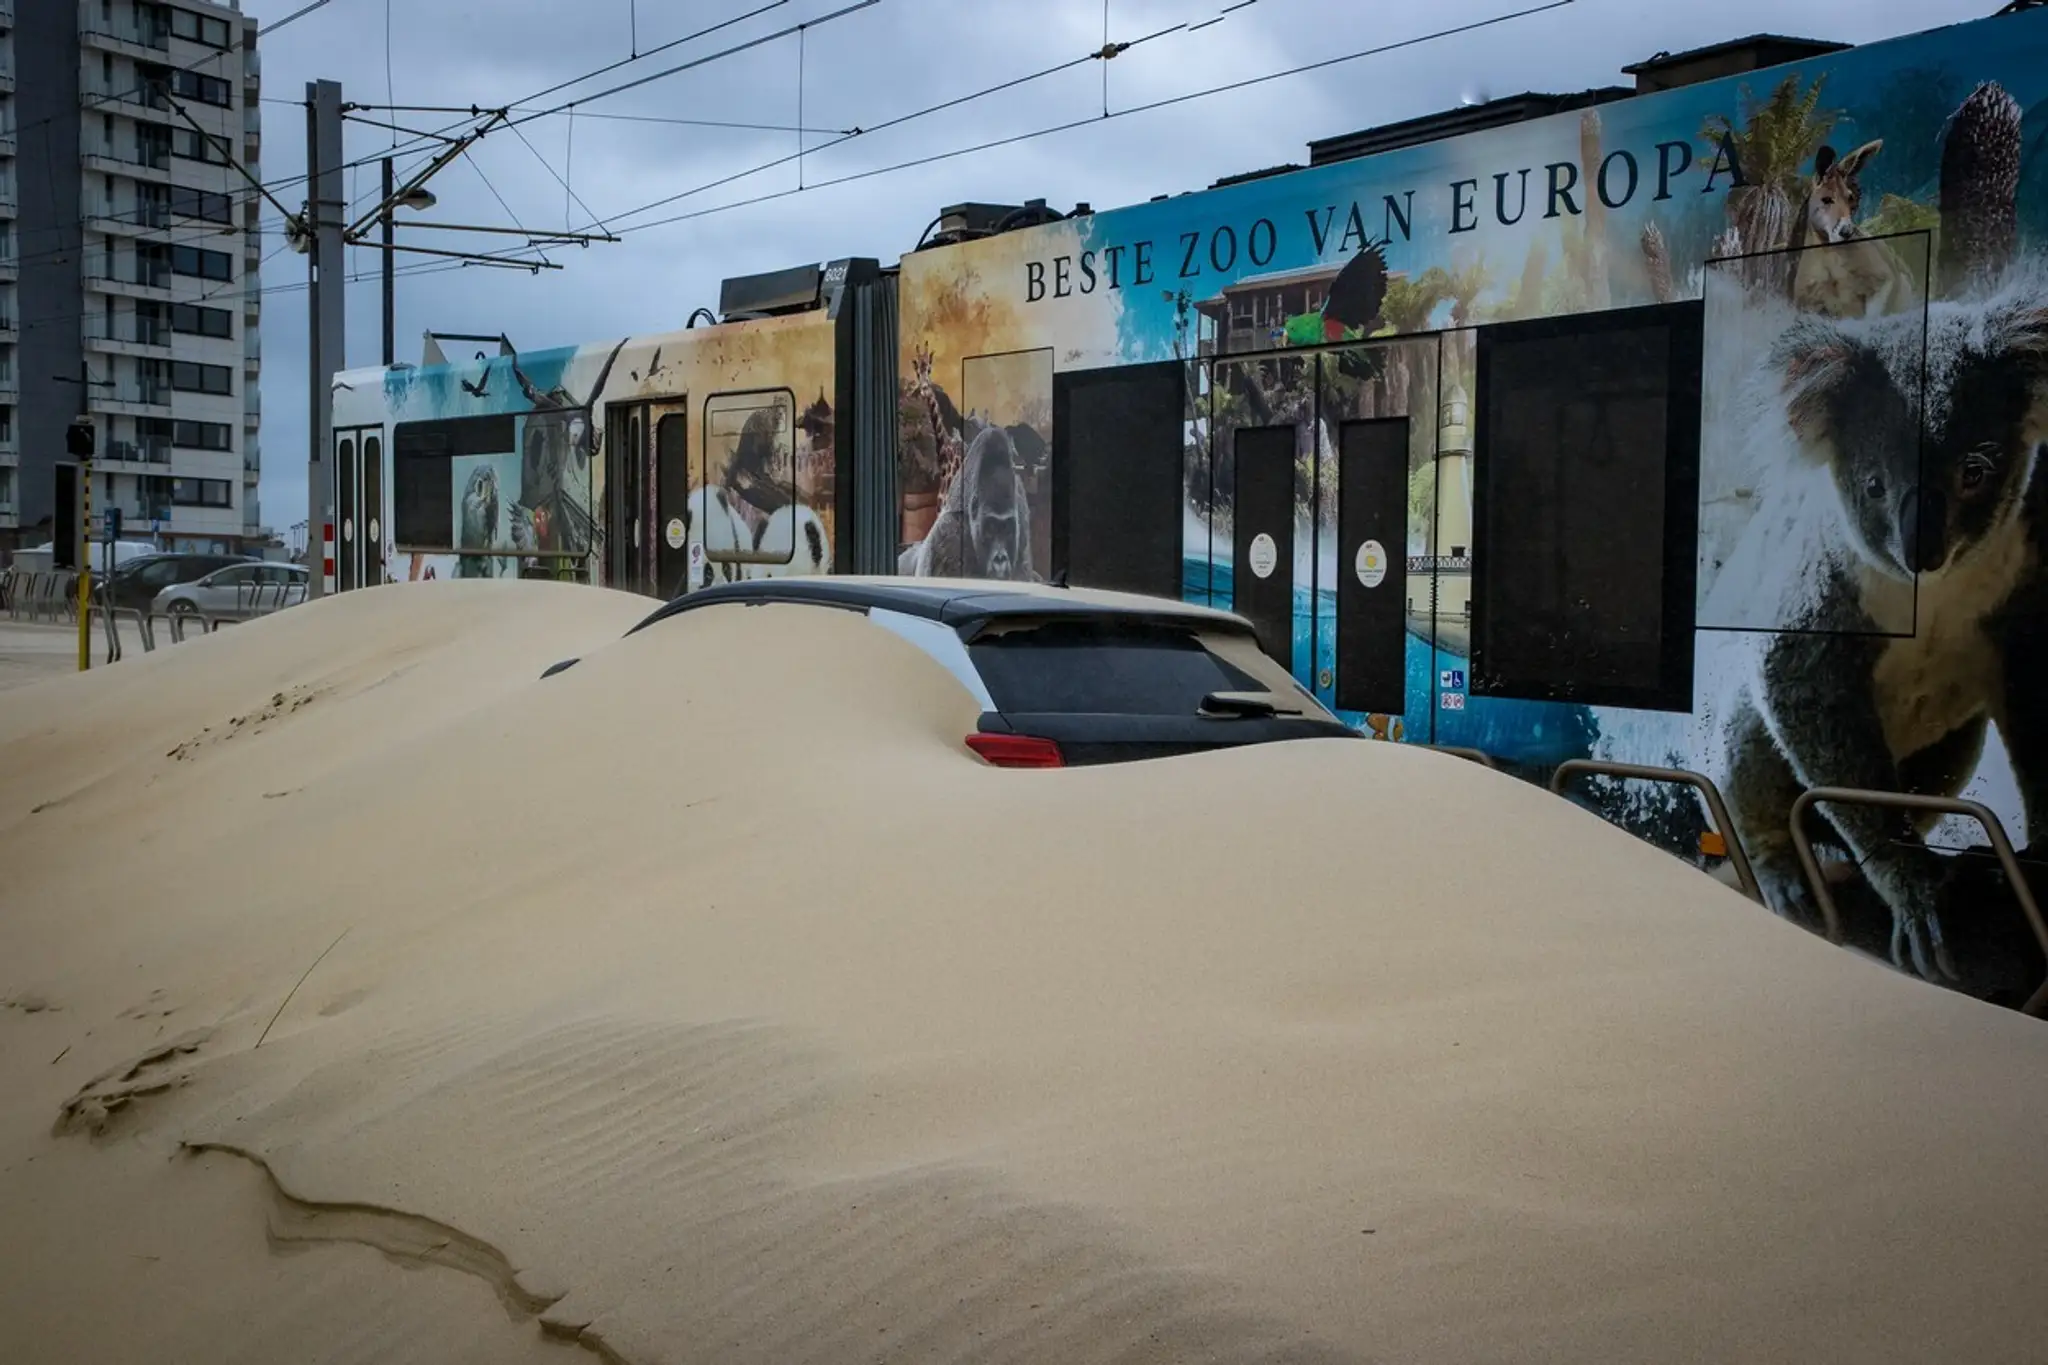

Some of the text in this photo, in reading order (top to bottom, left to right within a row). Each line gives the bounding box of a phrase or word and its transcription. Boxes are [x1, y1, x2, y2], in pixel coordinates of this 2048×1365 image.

[1026, 131, 1750, 303] BESTE ZOO VAN EUROPA
